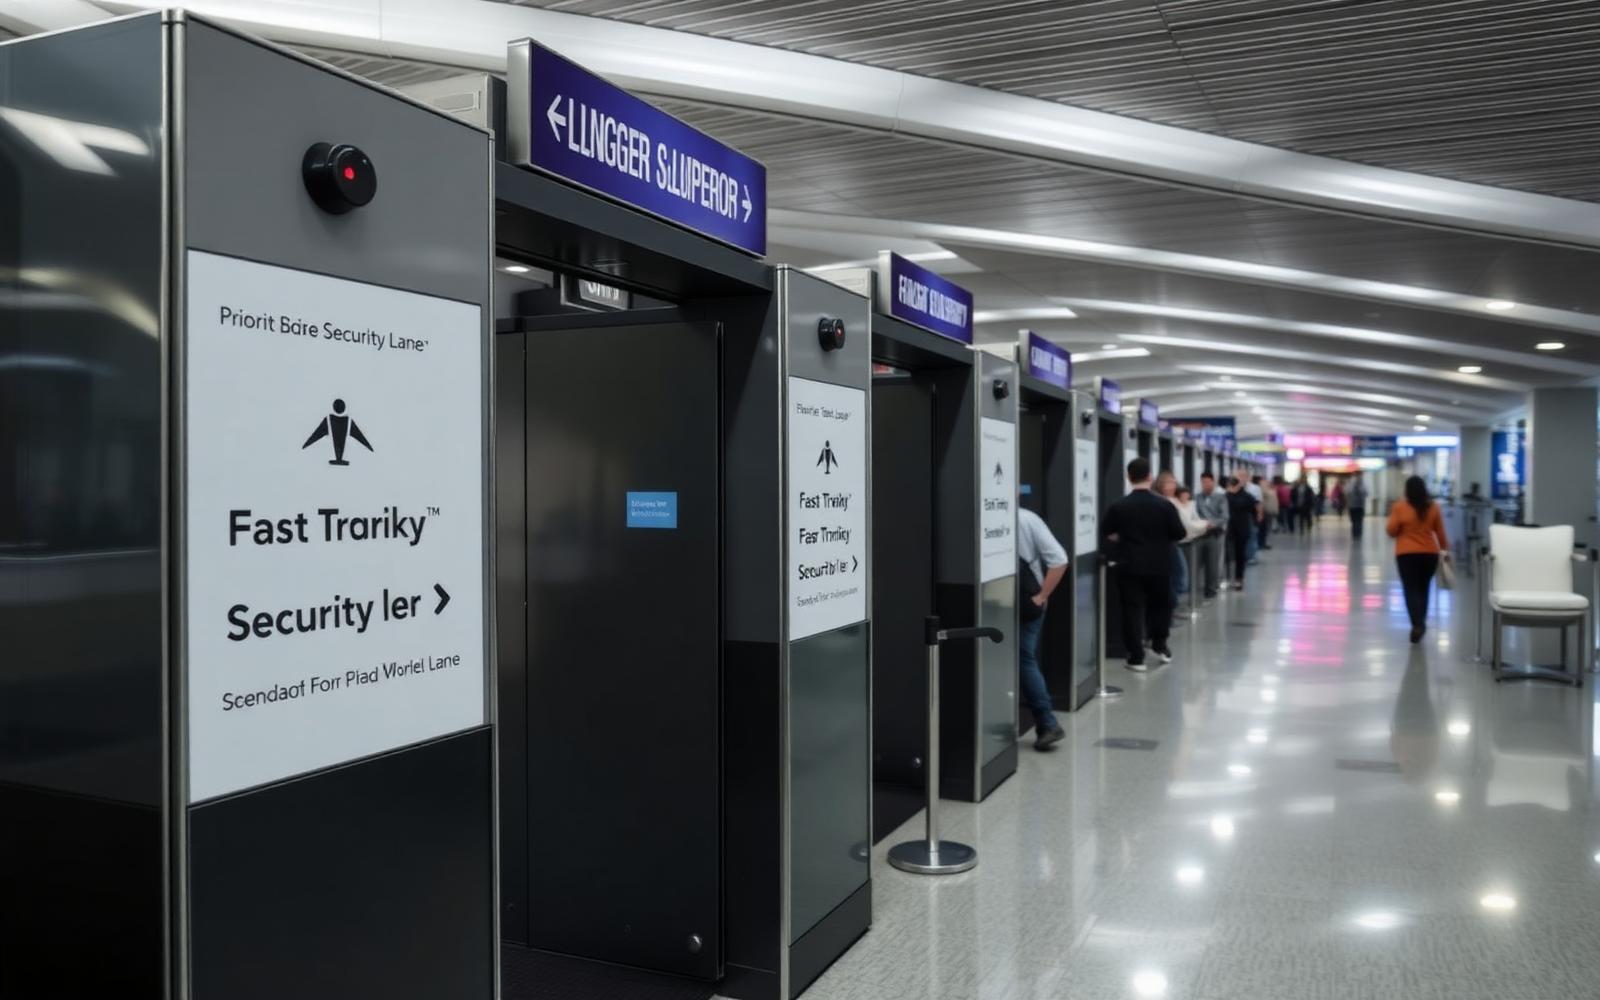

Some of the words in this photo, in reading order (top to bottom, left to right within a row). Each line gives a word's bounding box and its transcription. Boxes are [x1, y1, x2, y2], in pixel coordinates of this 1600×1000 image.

[220, 306, 275, 332] Priorit
[323, 322, 386, 351] Security
[229, 509, 308, 546] Fast
[227, 594, 374, 642] Security
[428, 653, 461, 672] Lane
